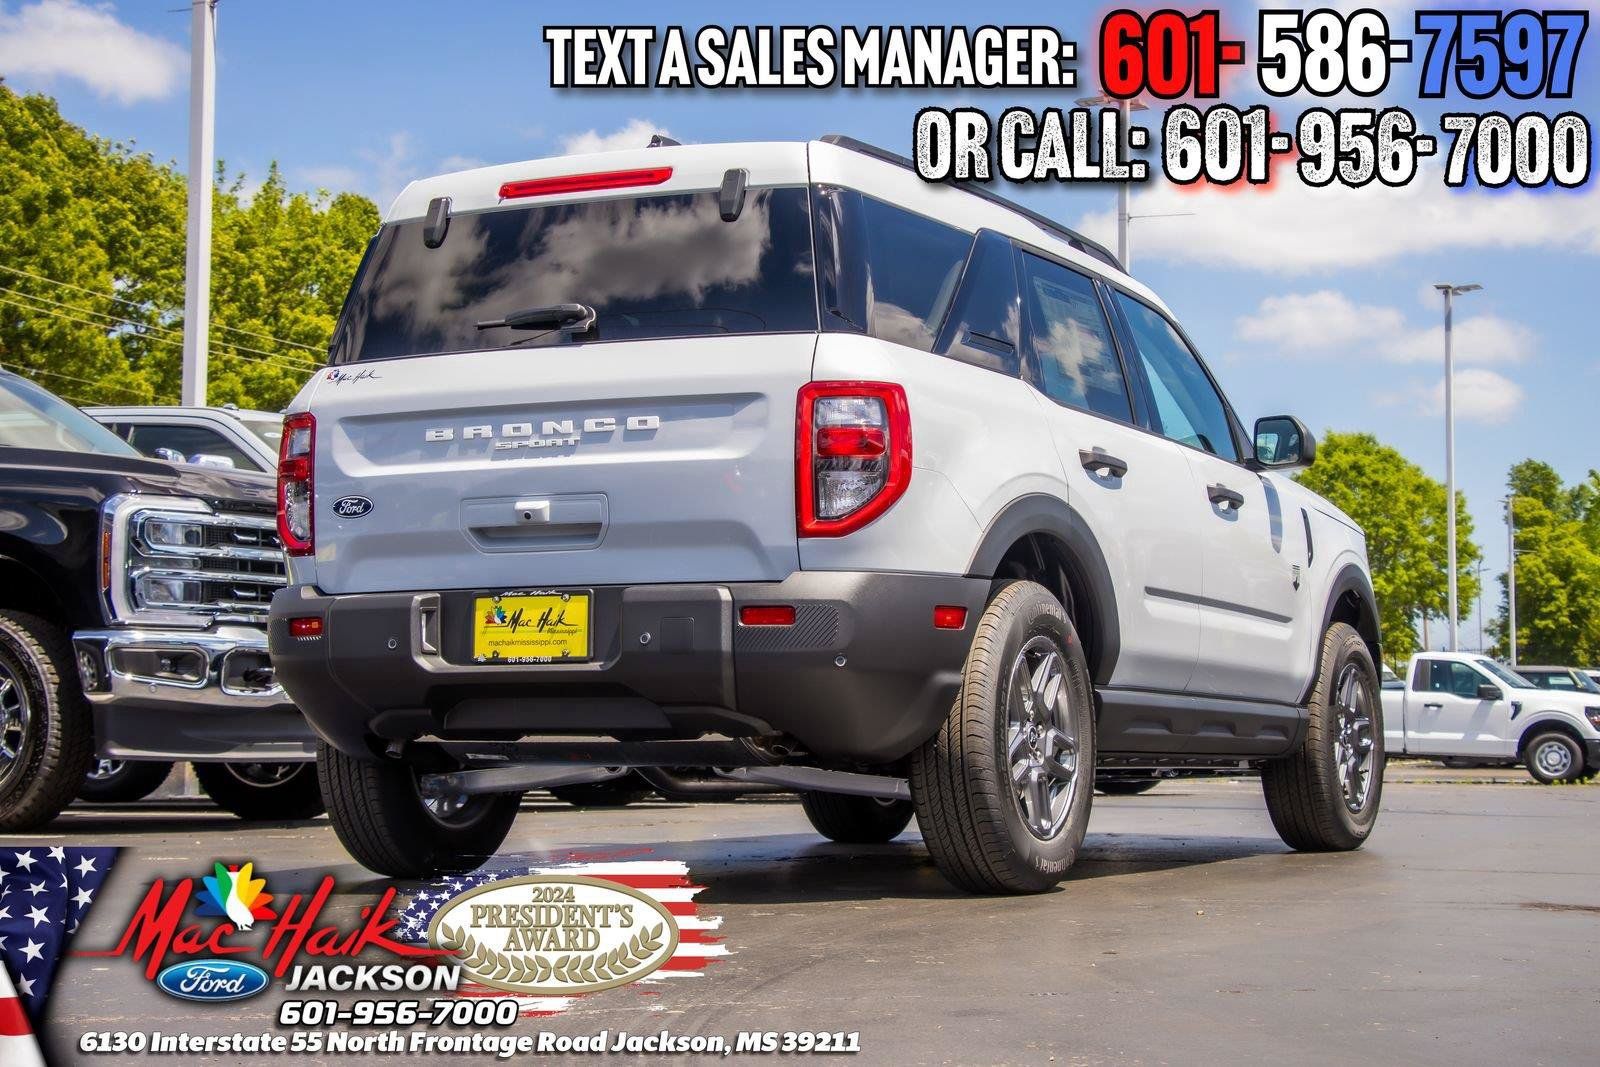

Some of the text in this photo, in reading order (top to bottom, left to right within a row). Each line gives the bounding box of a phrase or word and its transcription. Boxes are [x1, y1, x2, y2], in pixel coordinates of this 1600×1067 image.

[425, 415, 660, 442] BRONCO
[495, 437, 581, 451] SPORT
[338, 499, 366, 514] Ford
[492, 607, 578, 634] Mac Haik
[488, 638, 568, 647] machaikmississippi.com
